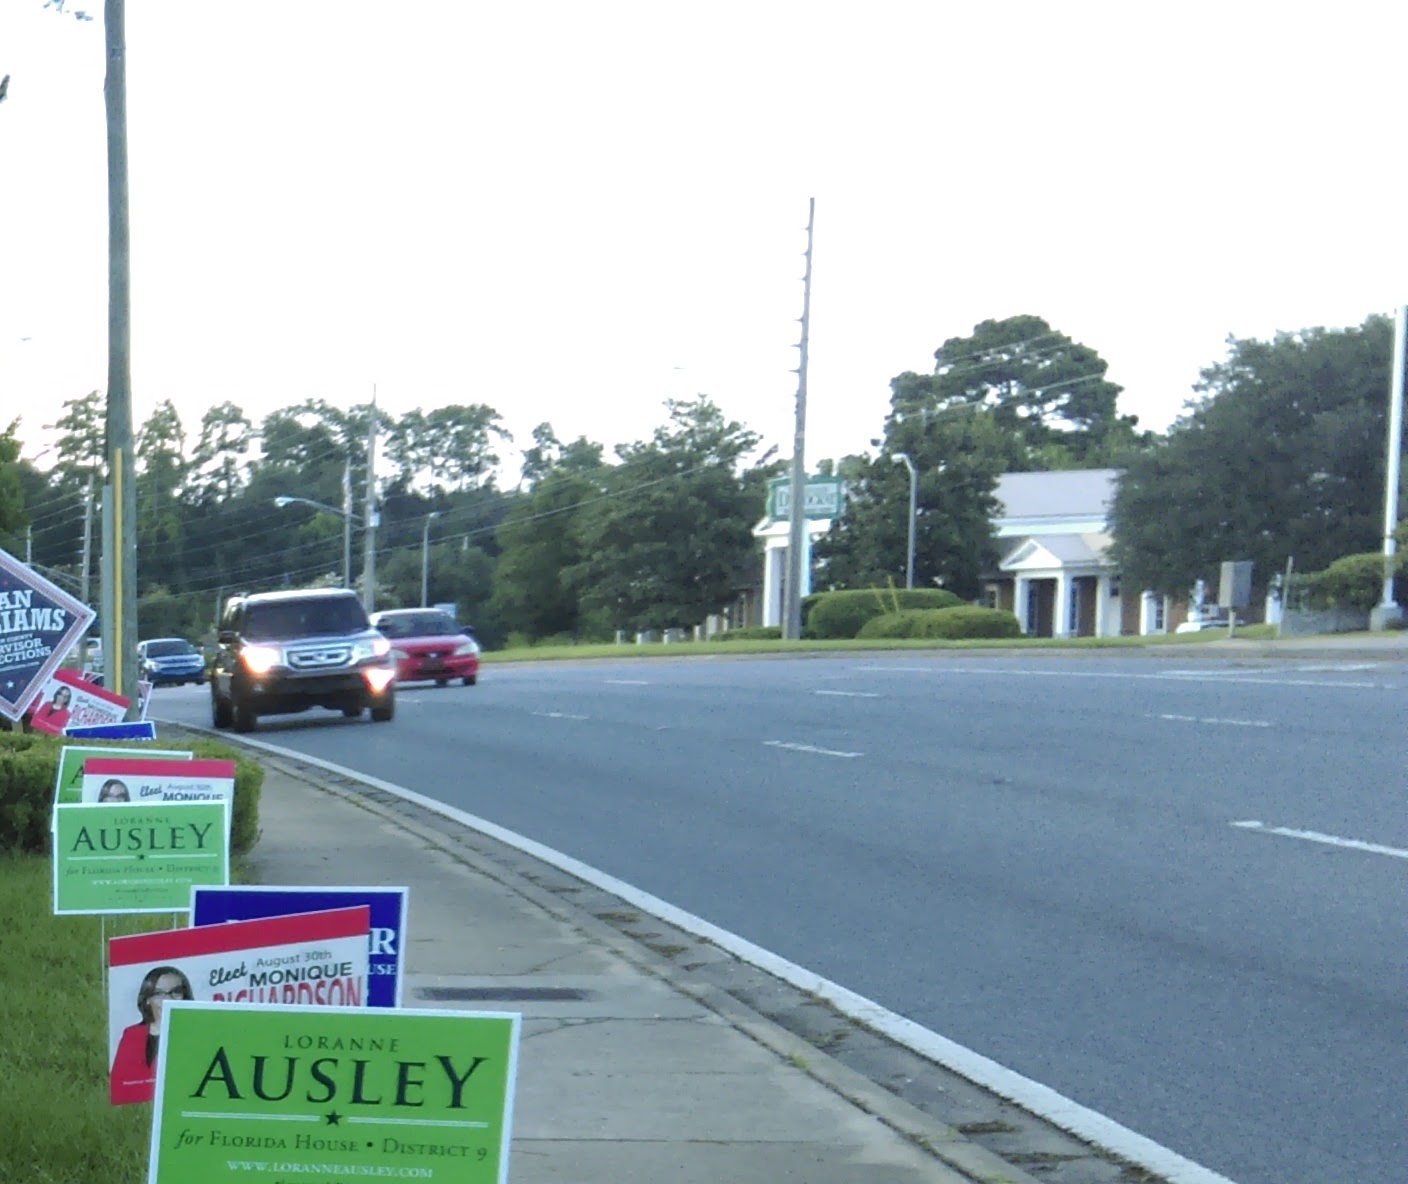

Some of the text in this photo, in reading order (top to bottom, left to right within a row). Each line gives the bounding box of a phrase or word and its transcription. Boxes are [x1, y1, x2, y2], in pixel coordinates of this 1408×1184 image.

[71, 823, 213, 851] AUSLEY
[209, 950, 332, 987] Elect August 30th
[250, 961, 353, 988] MONIQUE
[285, 1035, 400, 1053] LORANNE
[189, 1046, 489, 1109] AUSLEY
[174, 1129, 487, 1160] for FLORIDA HOUSE DISTRICT 9
